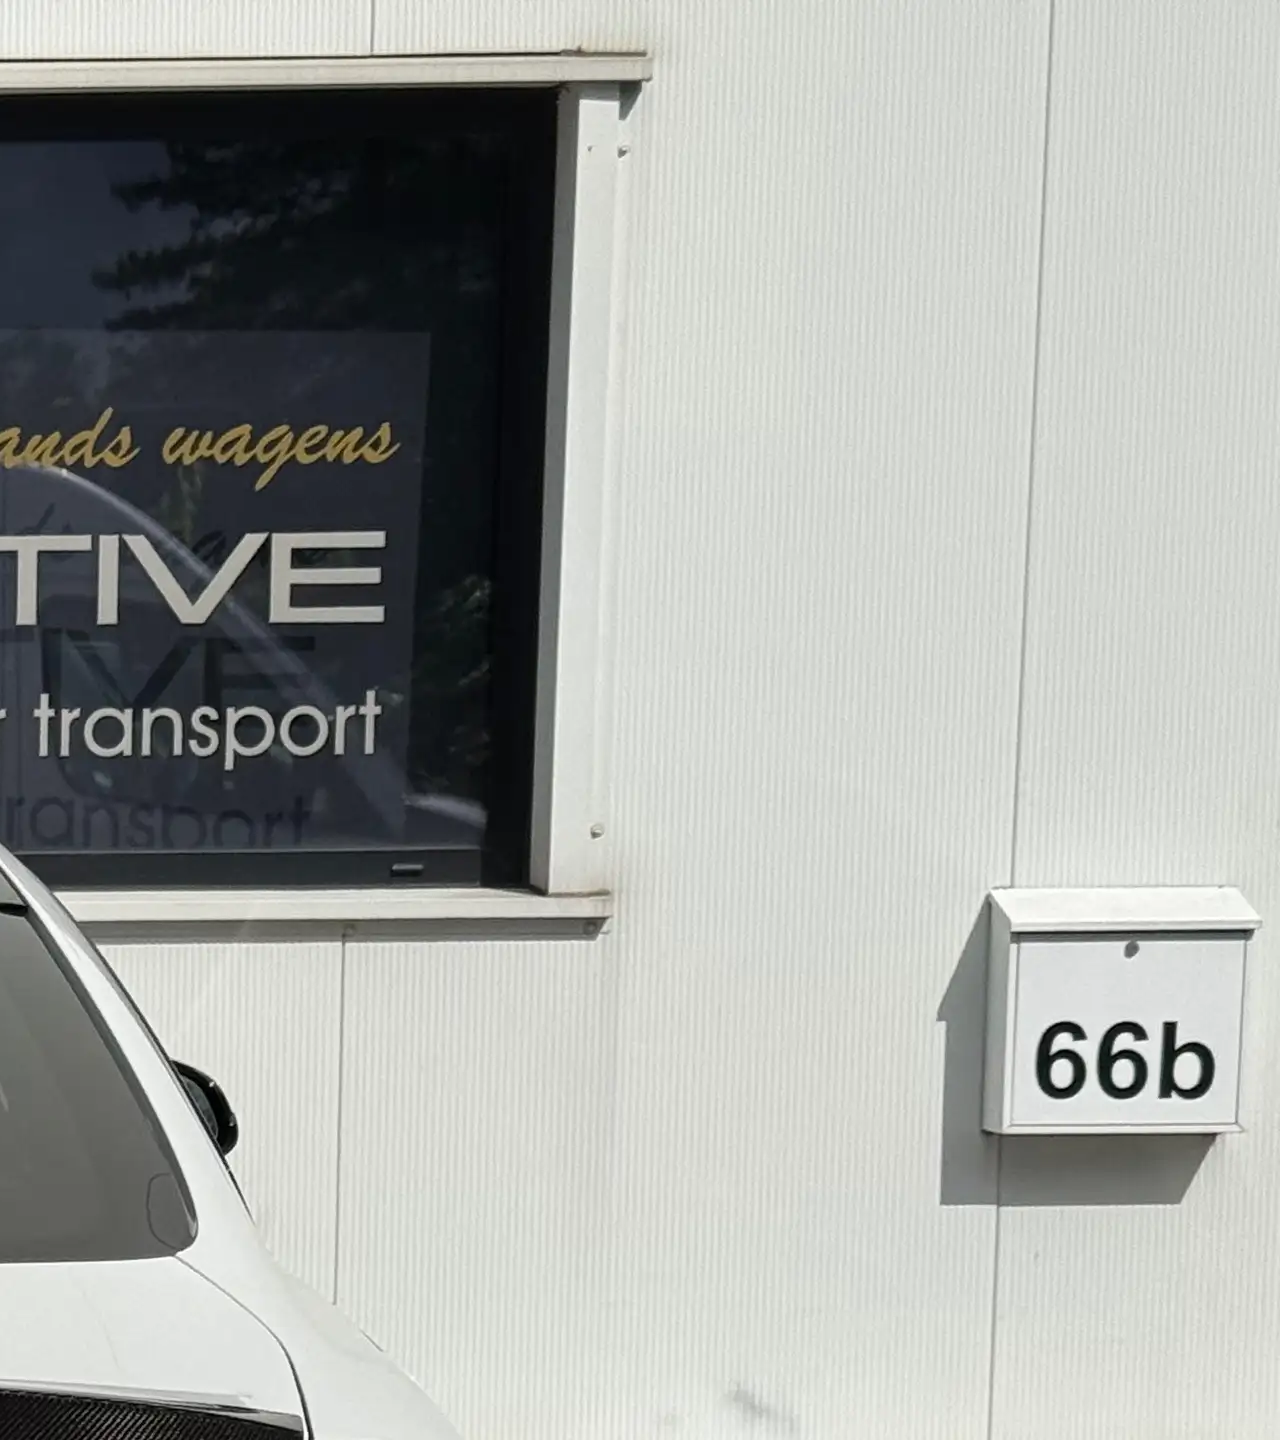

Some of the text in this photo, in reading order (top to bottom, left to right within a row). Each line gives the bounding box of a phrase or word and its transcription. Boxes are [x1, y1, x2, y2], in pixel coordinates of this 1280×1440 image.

[161, 421, 402, 491] wagens
[33, 689, 383, 771] transport
[1034, 1019, 1216, 1100] 66b
